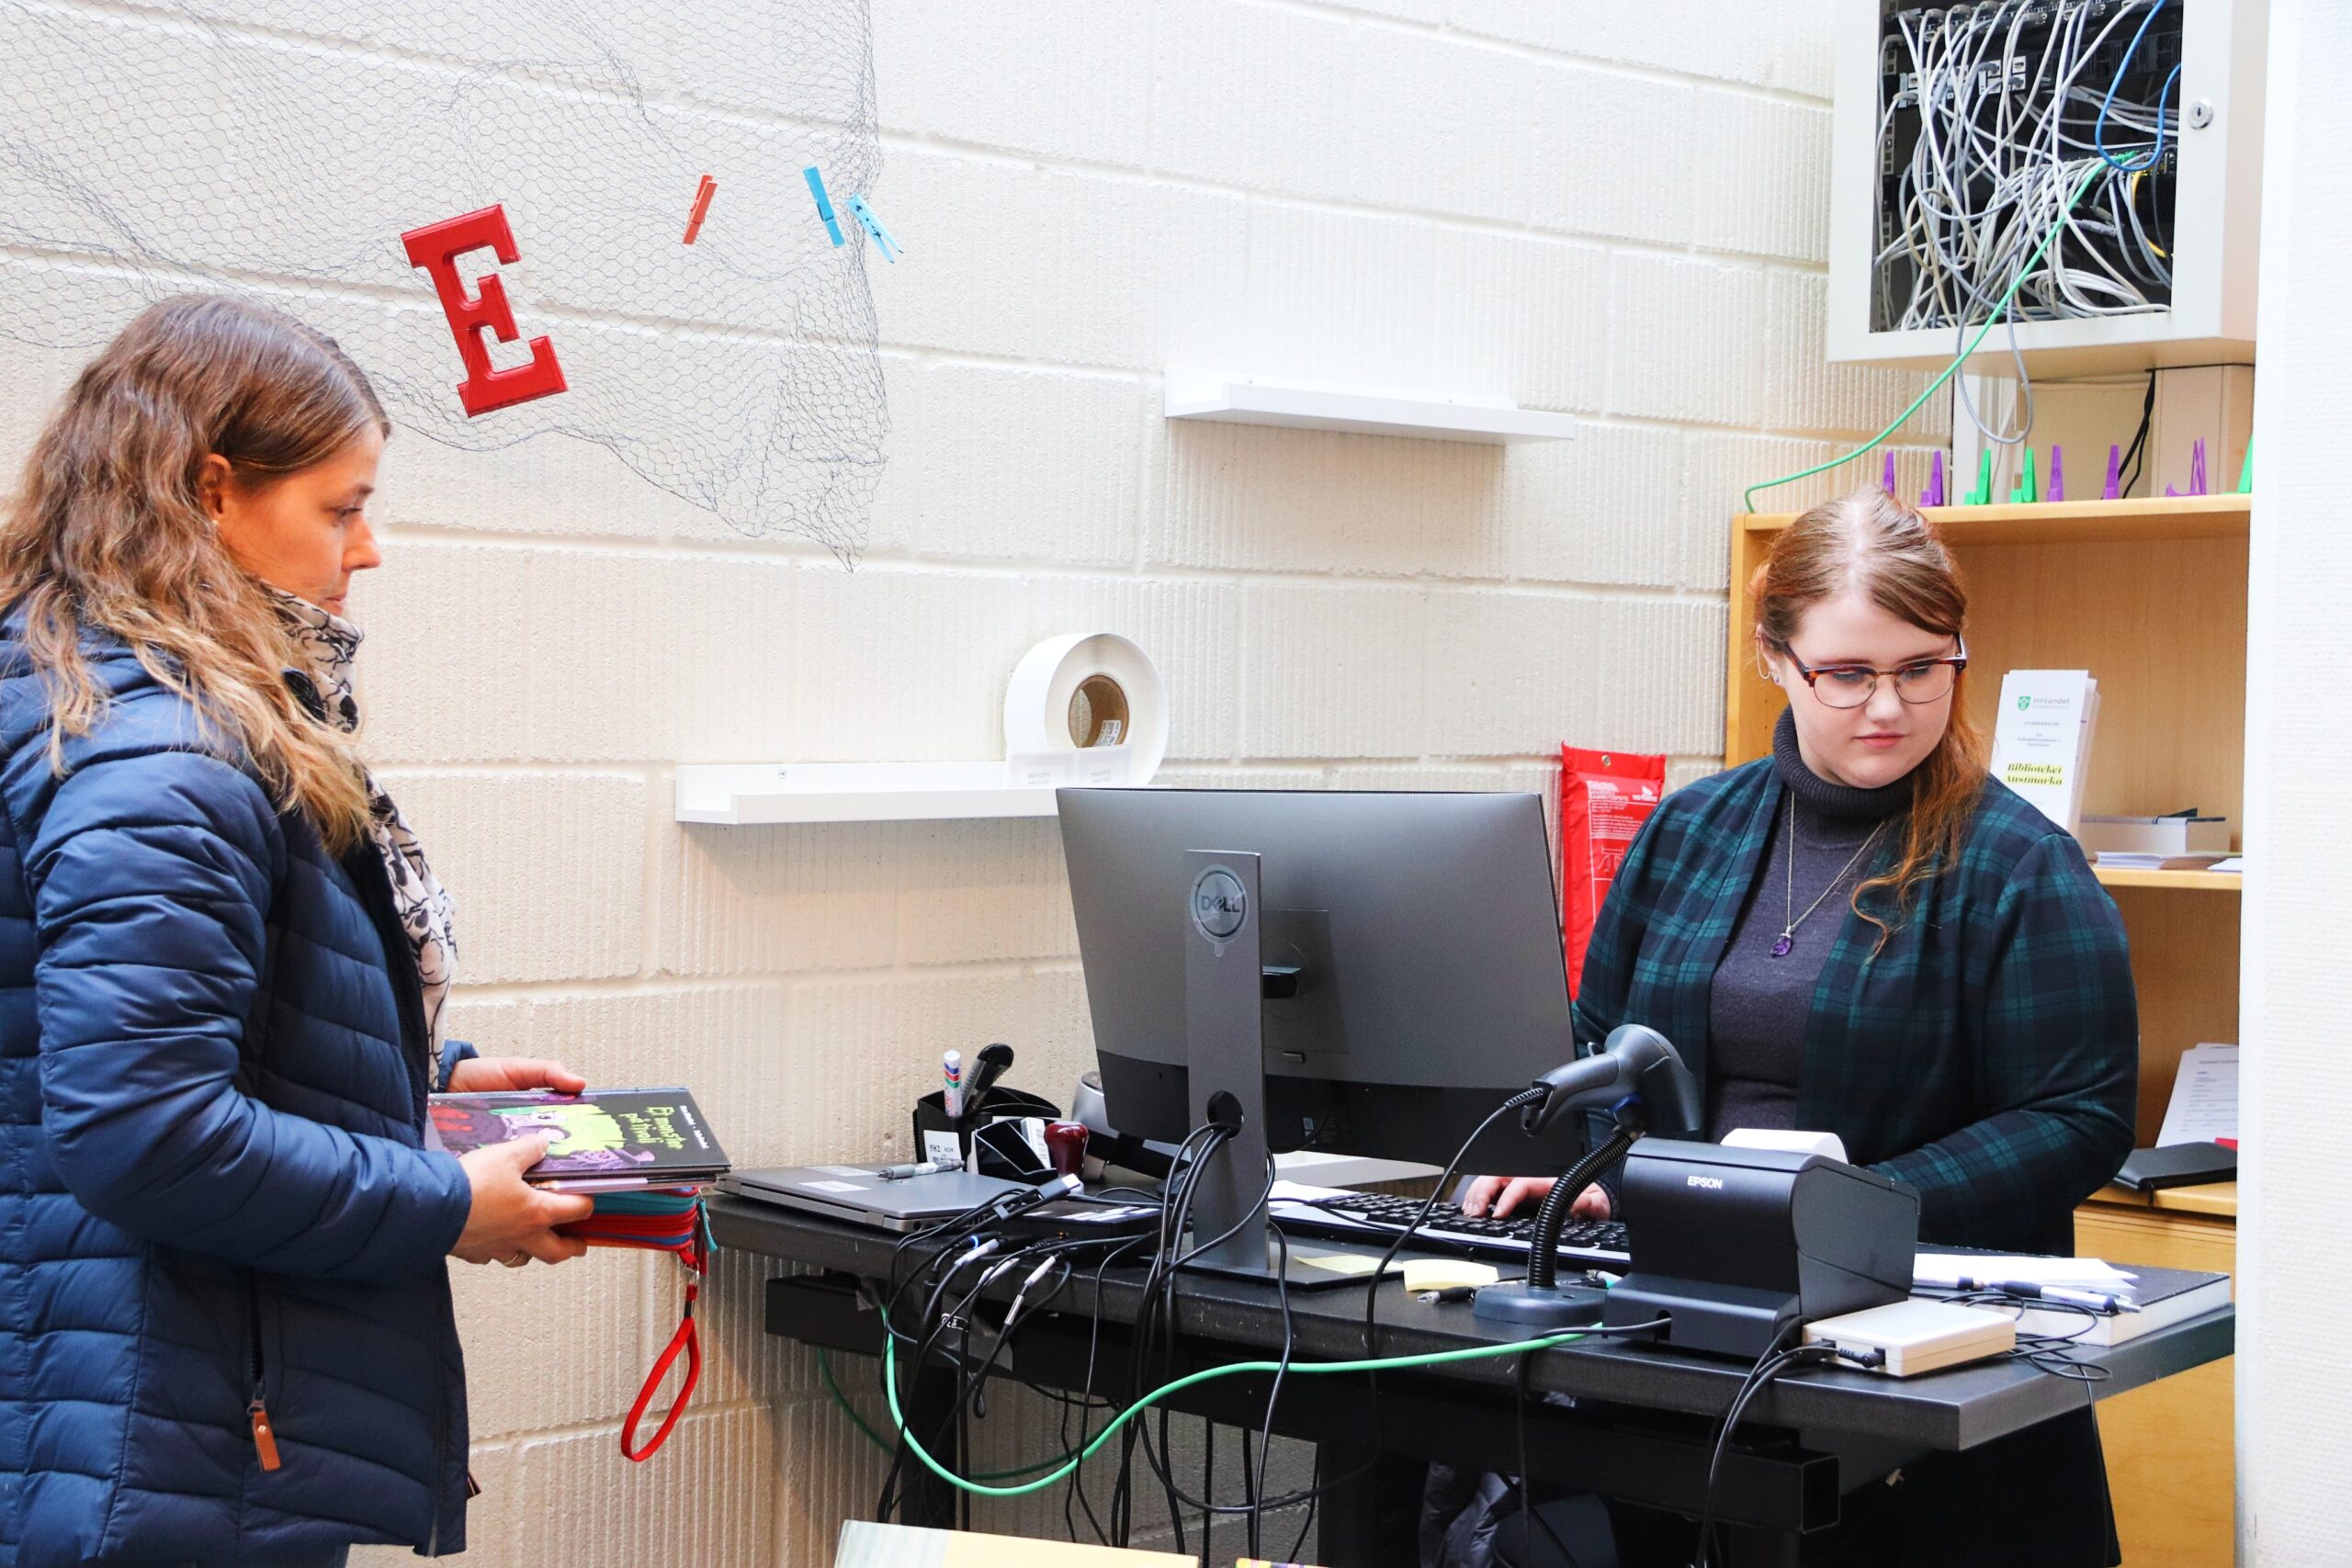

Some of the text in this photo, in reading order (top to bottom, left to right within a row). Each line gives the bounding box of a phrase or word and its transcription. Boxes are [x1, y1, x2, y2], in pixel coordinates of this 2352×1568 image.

[401, 203, 569, 418] E
[2007, 763, 2062, 773] Biblioteket
[2007, 775, 2063, 785] Austmarka
[1201, 896, 1240, 913] DELL
[653, 1117, 687, 1150] monster
[1687, 1176, 1723, 1190] EPSON
